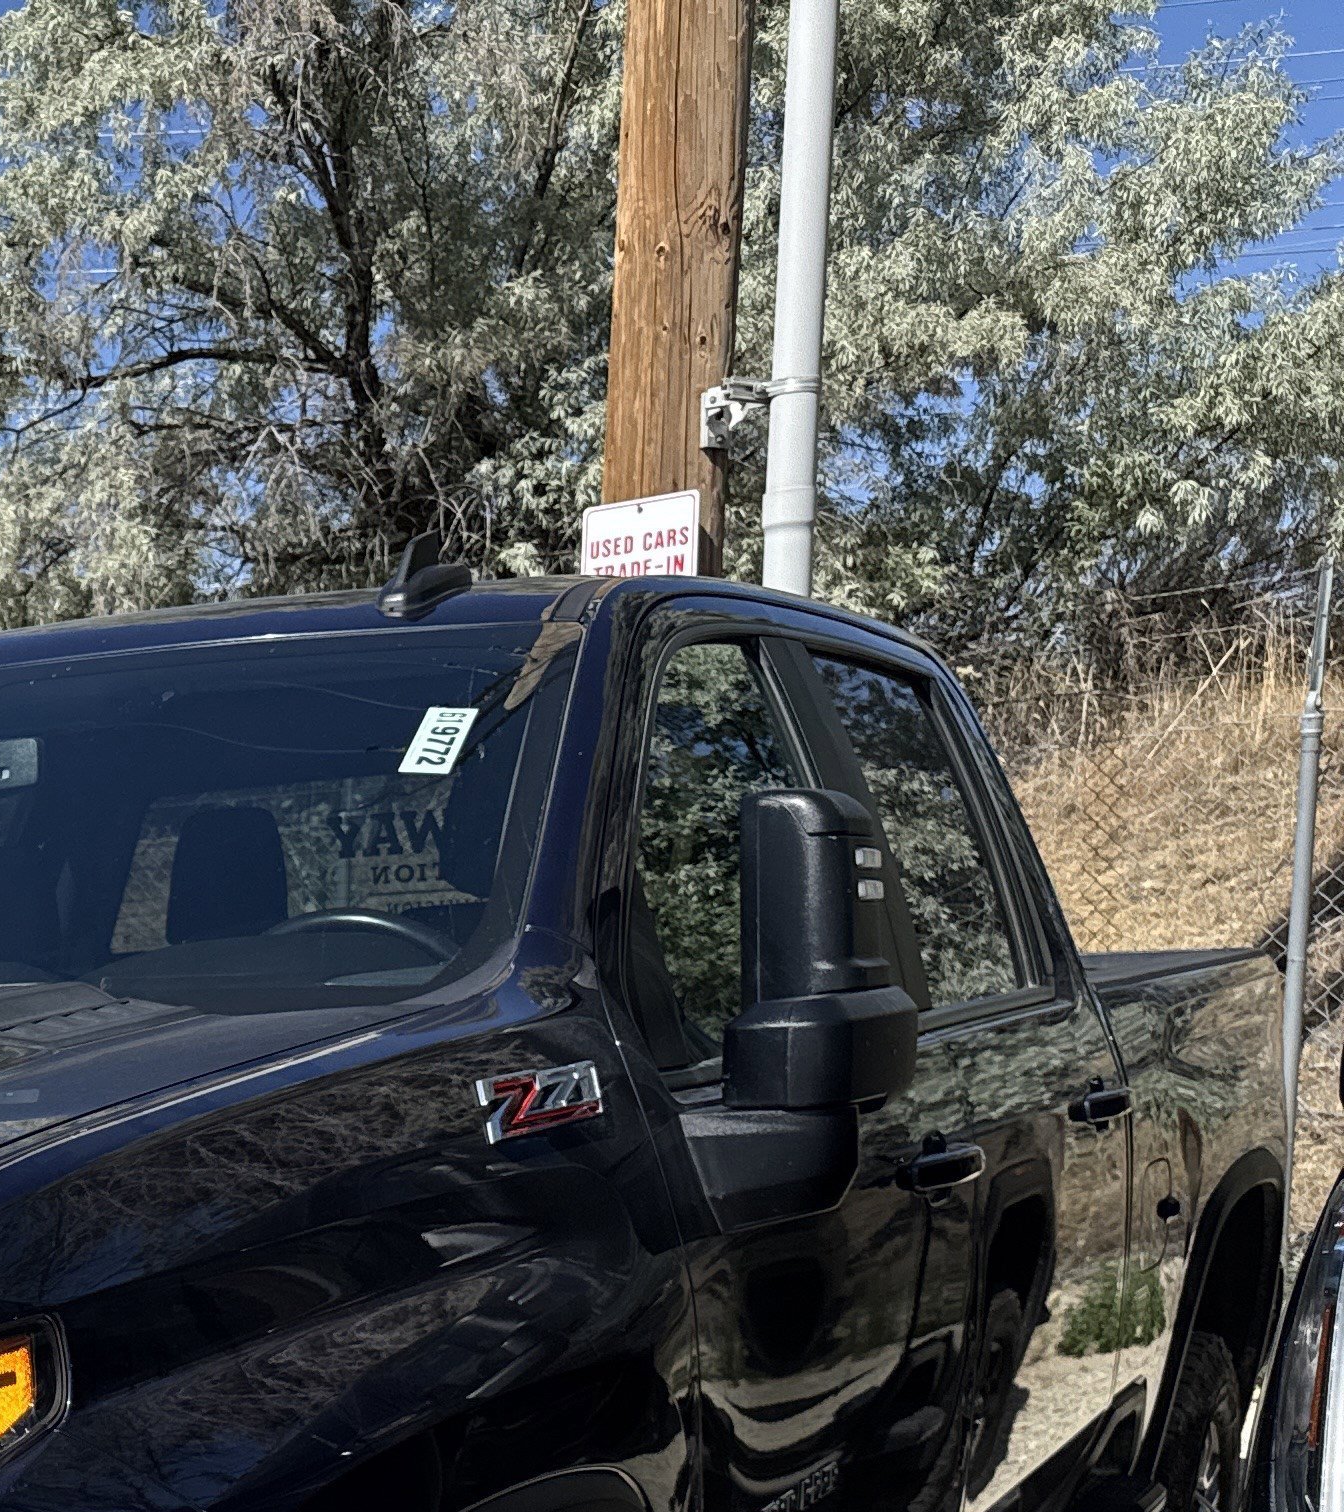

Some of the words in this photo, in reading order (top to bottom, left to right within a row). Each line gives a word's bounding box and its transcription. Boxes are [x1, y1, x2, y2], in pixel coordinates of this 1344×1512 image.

[590, 535, 633, 560] USED
[642, 526, 689, 551] CARS
[593, 553, 685, 577] TRADE-IN
[415, 712, 467, 766] 619772
[476, 1060, 603, 1145] Z71
